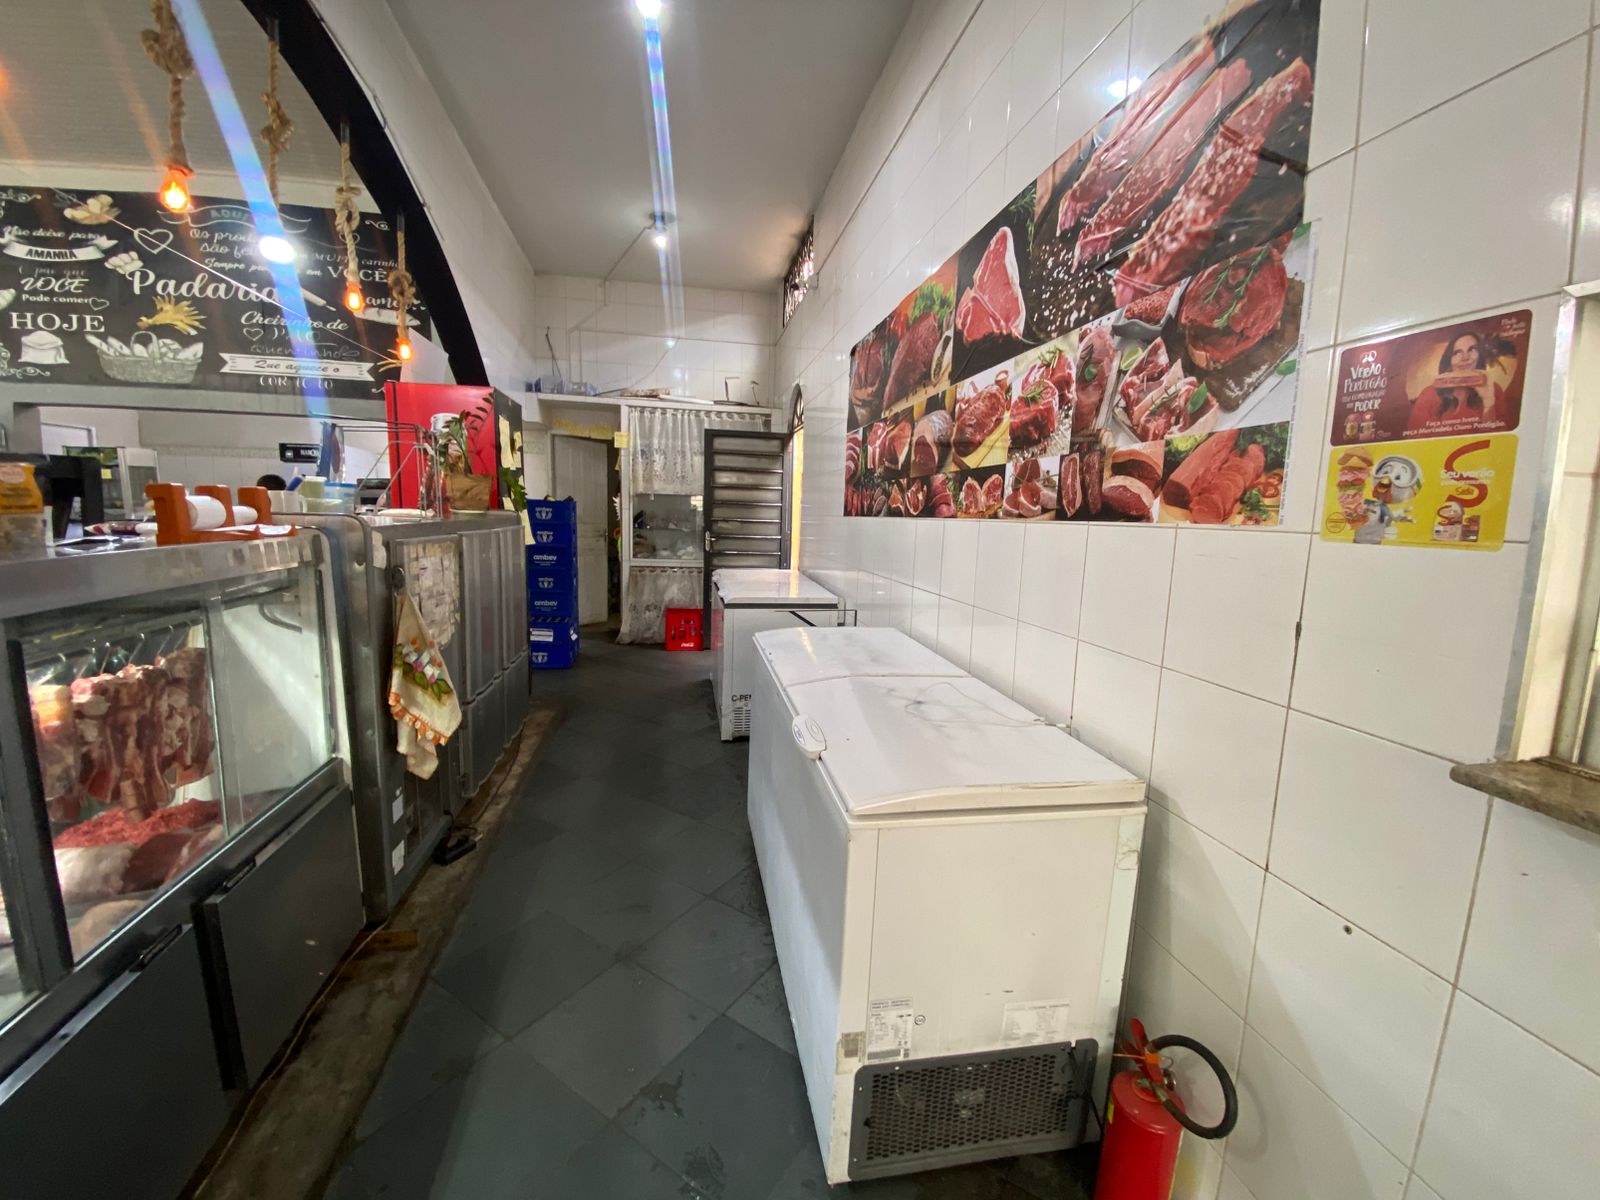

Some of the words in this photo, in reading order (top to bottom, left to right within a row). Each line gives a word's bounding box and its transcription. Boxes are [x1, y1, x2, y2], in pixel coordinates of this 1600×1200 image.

[125, 268, 281, 304] Padaria
[22, 294, 51, 302] Pode
[9, 311, 105, 332] HOJE
